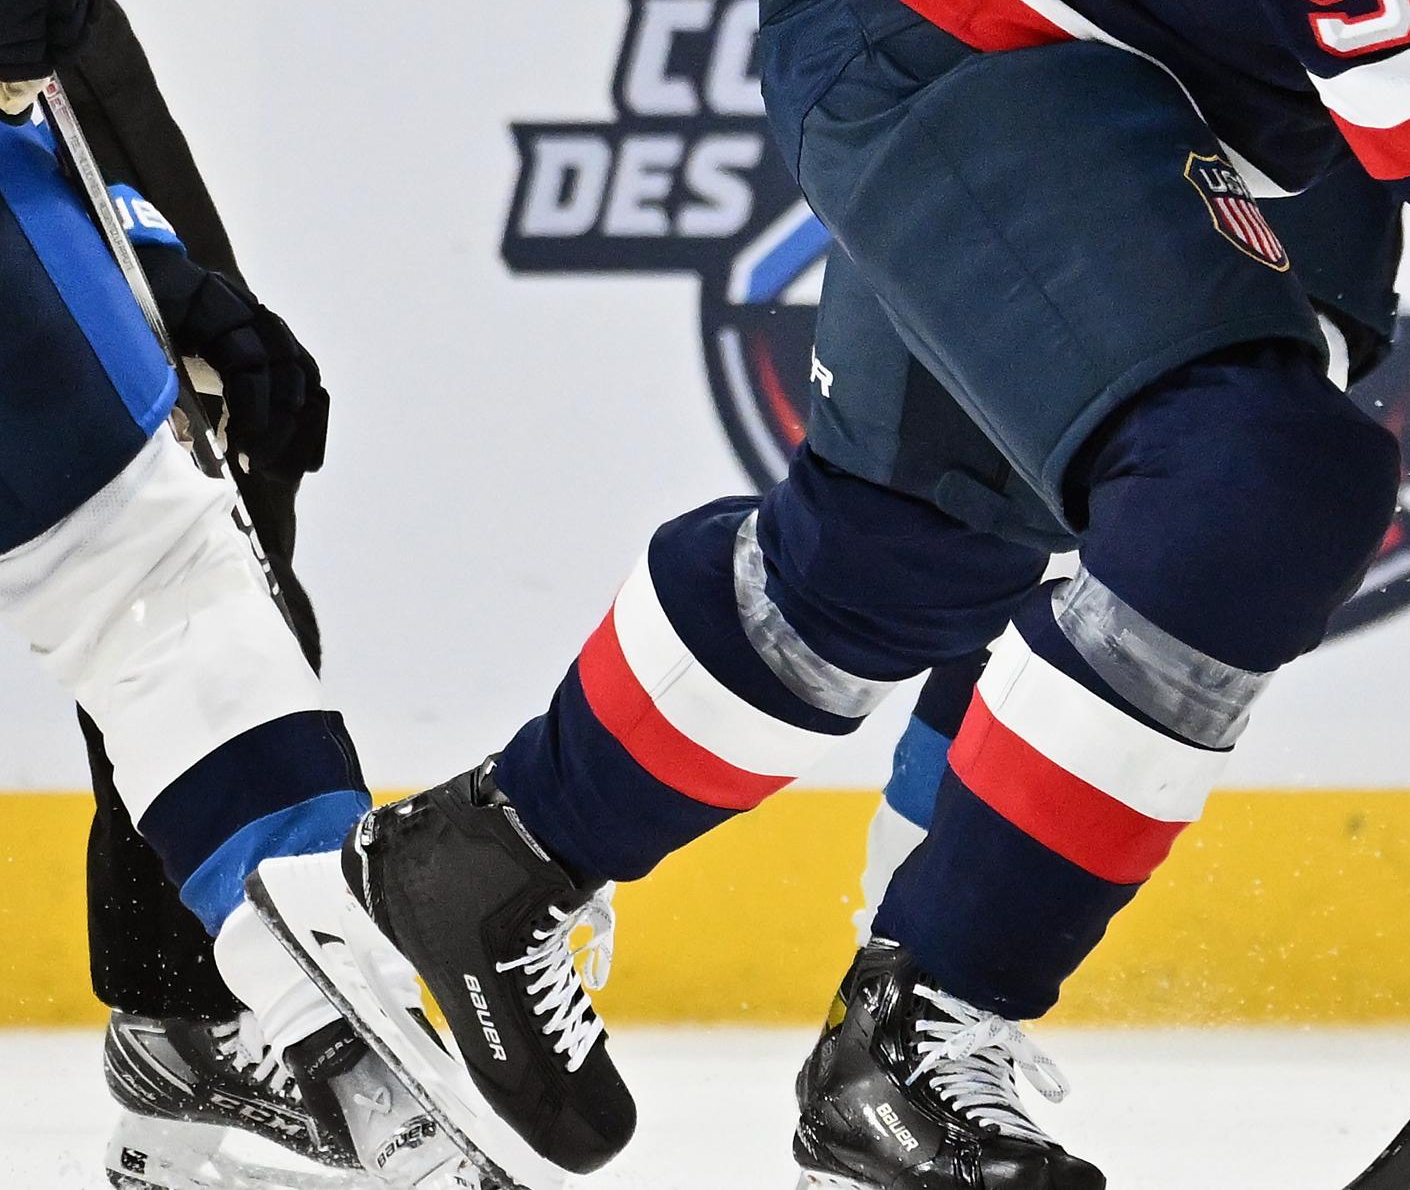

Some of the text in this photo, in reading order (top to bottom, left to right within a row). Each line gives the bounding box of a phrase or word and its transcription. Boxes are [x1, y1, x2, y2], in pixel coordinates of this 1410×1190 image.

[516, 133, 765, 239] DES
[463, 973, 507, 1061] BAUER
[210, 1092, 311, 1138] CCM
[875, 1102, 920, 1153] BAUER
[376, 1117, 437, 1169] BAUER
